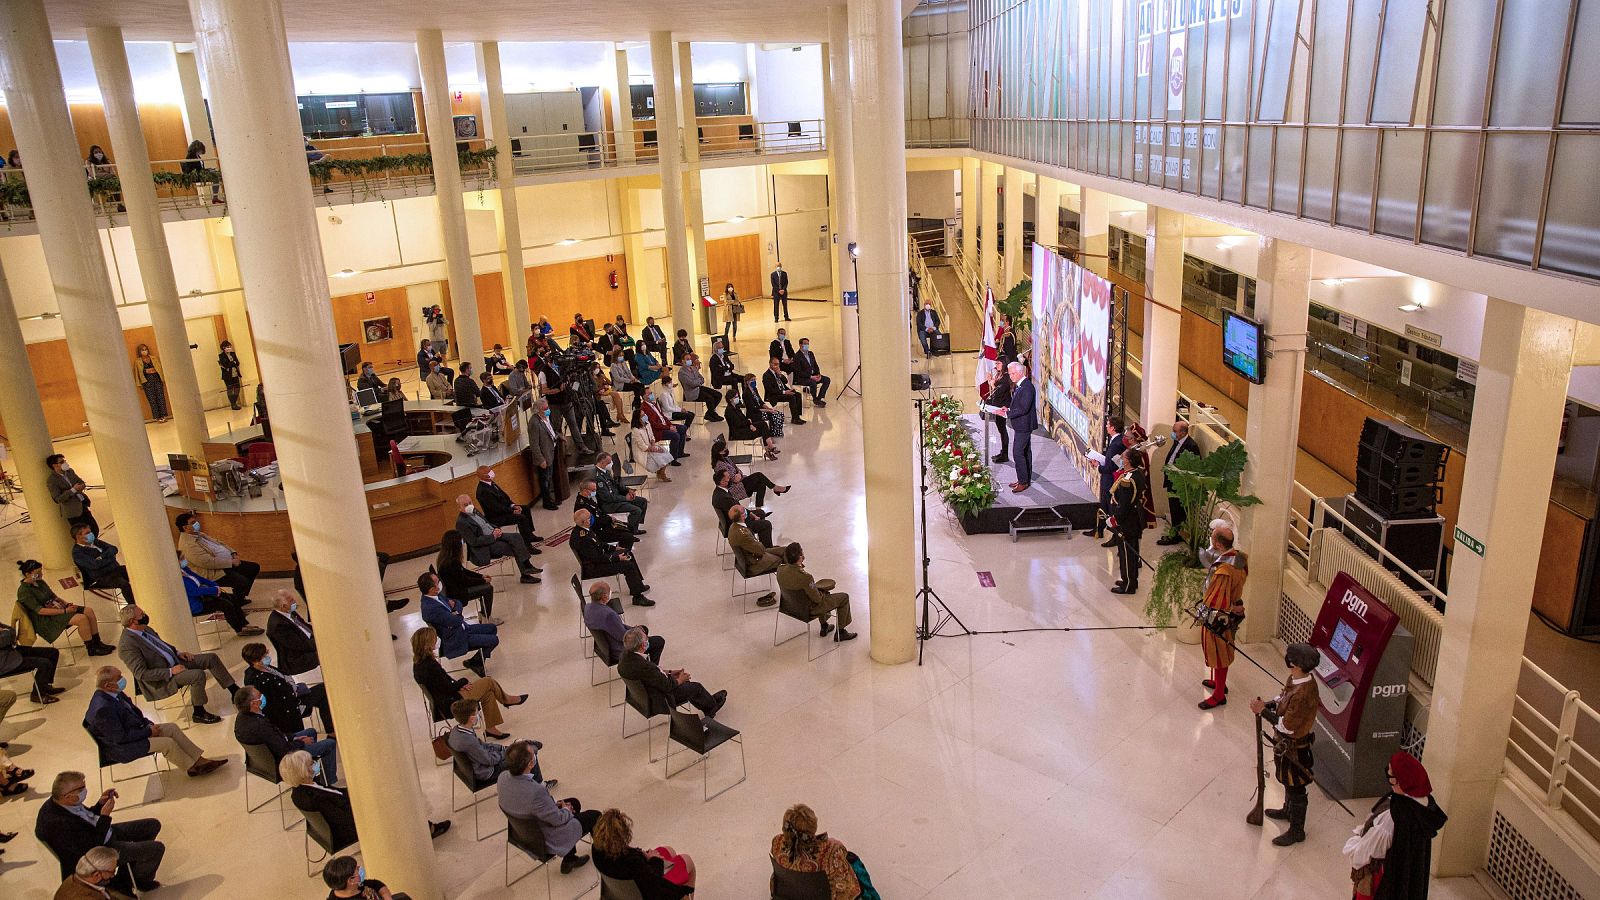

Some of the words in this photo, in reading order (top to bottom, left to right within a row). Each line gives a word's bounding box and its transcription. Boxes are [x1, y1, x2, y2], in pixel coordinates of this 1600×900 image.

[1456, 530, 1475, 548] SALIDA
[1341, 588, 1368, 617] pgm
[1372, 683, 1406, 698] pgm
